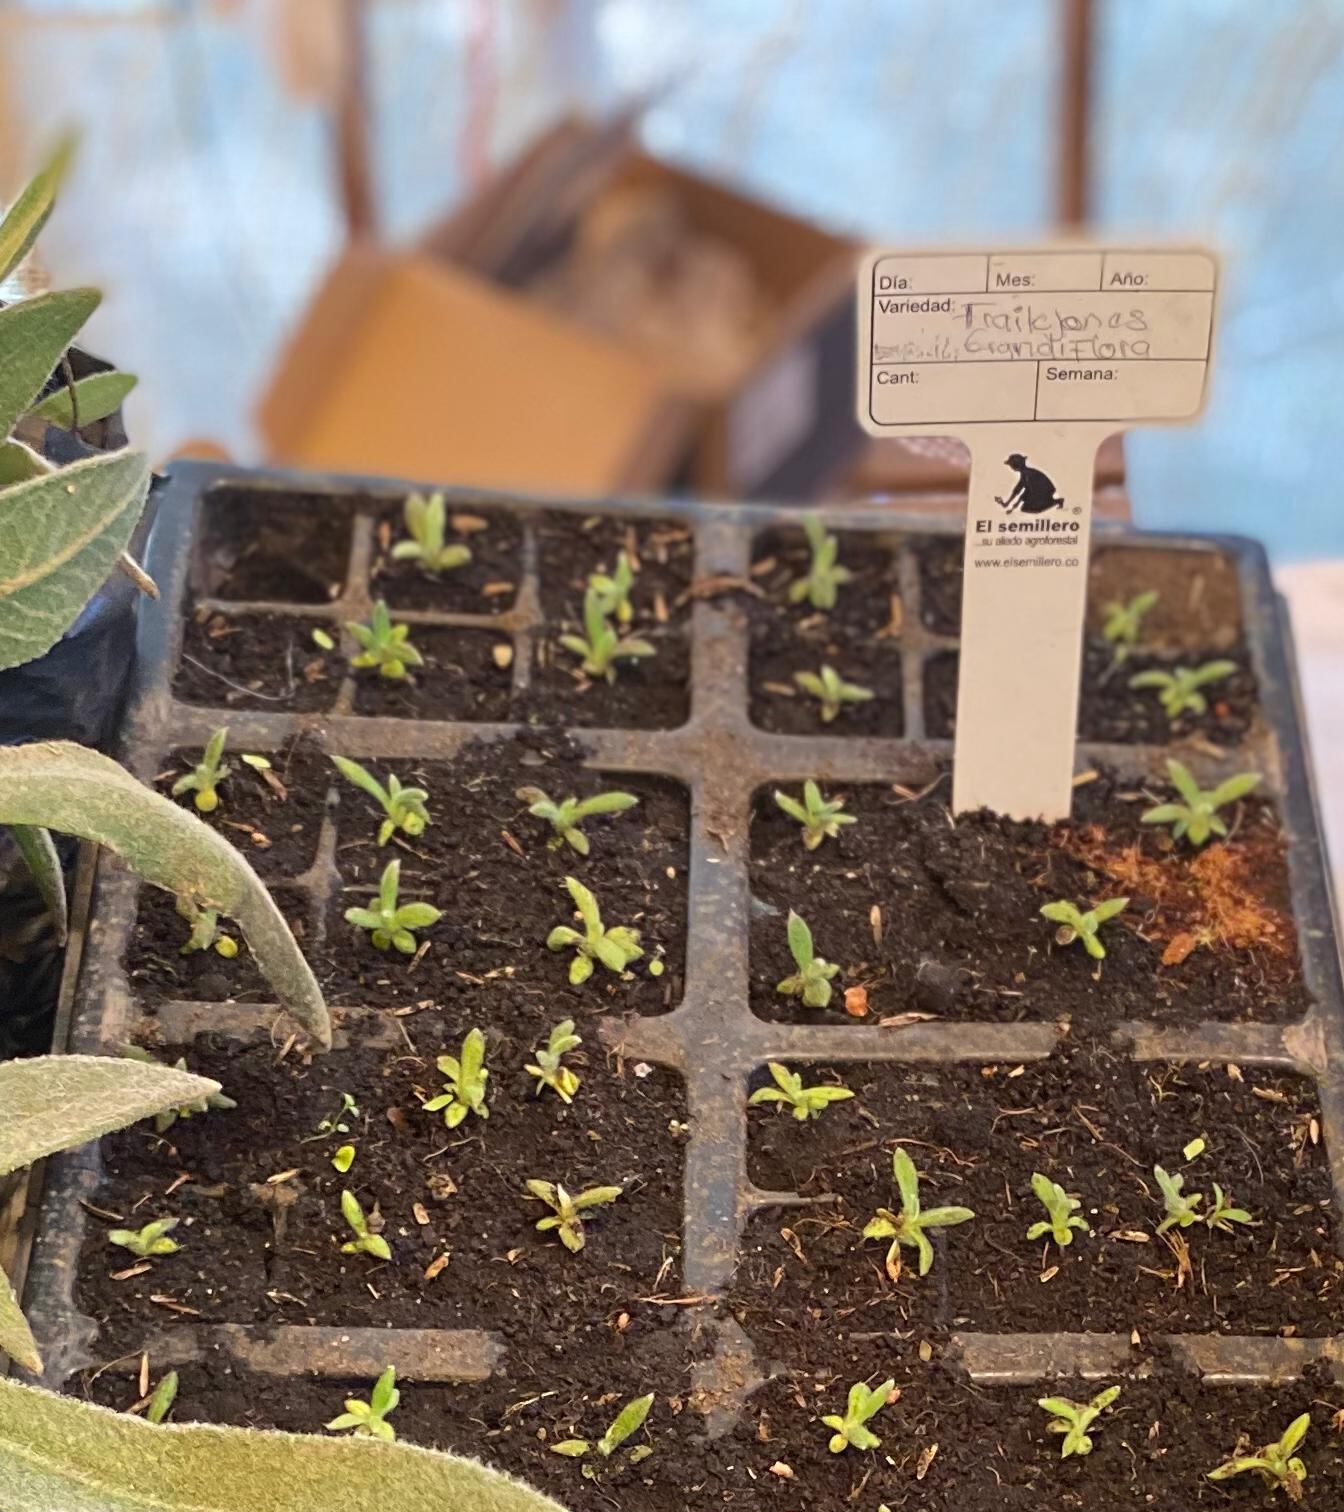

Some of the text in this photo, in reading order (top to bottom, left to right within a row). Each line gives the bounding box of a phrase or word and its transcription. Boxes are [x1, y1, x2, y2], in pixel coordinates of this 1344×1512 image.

[878, 275, 912, 290] Día:
[995, 273, 1036, 287] Mes:
[1109, 271, 1148, 286] Año:
[878, 298, 955, 314] Variedad:
[876, 371, 919, 385] Cant:
[1045, 367, 1118, 381] Semana:
[975, 518, 1081, 533] El semillero
